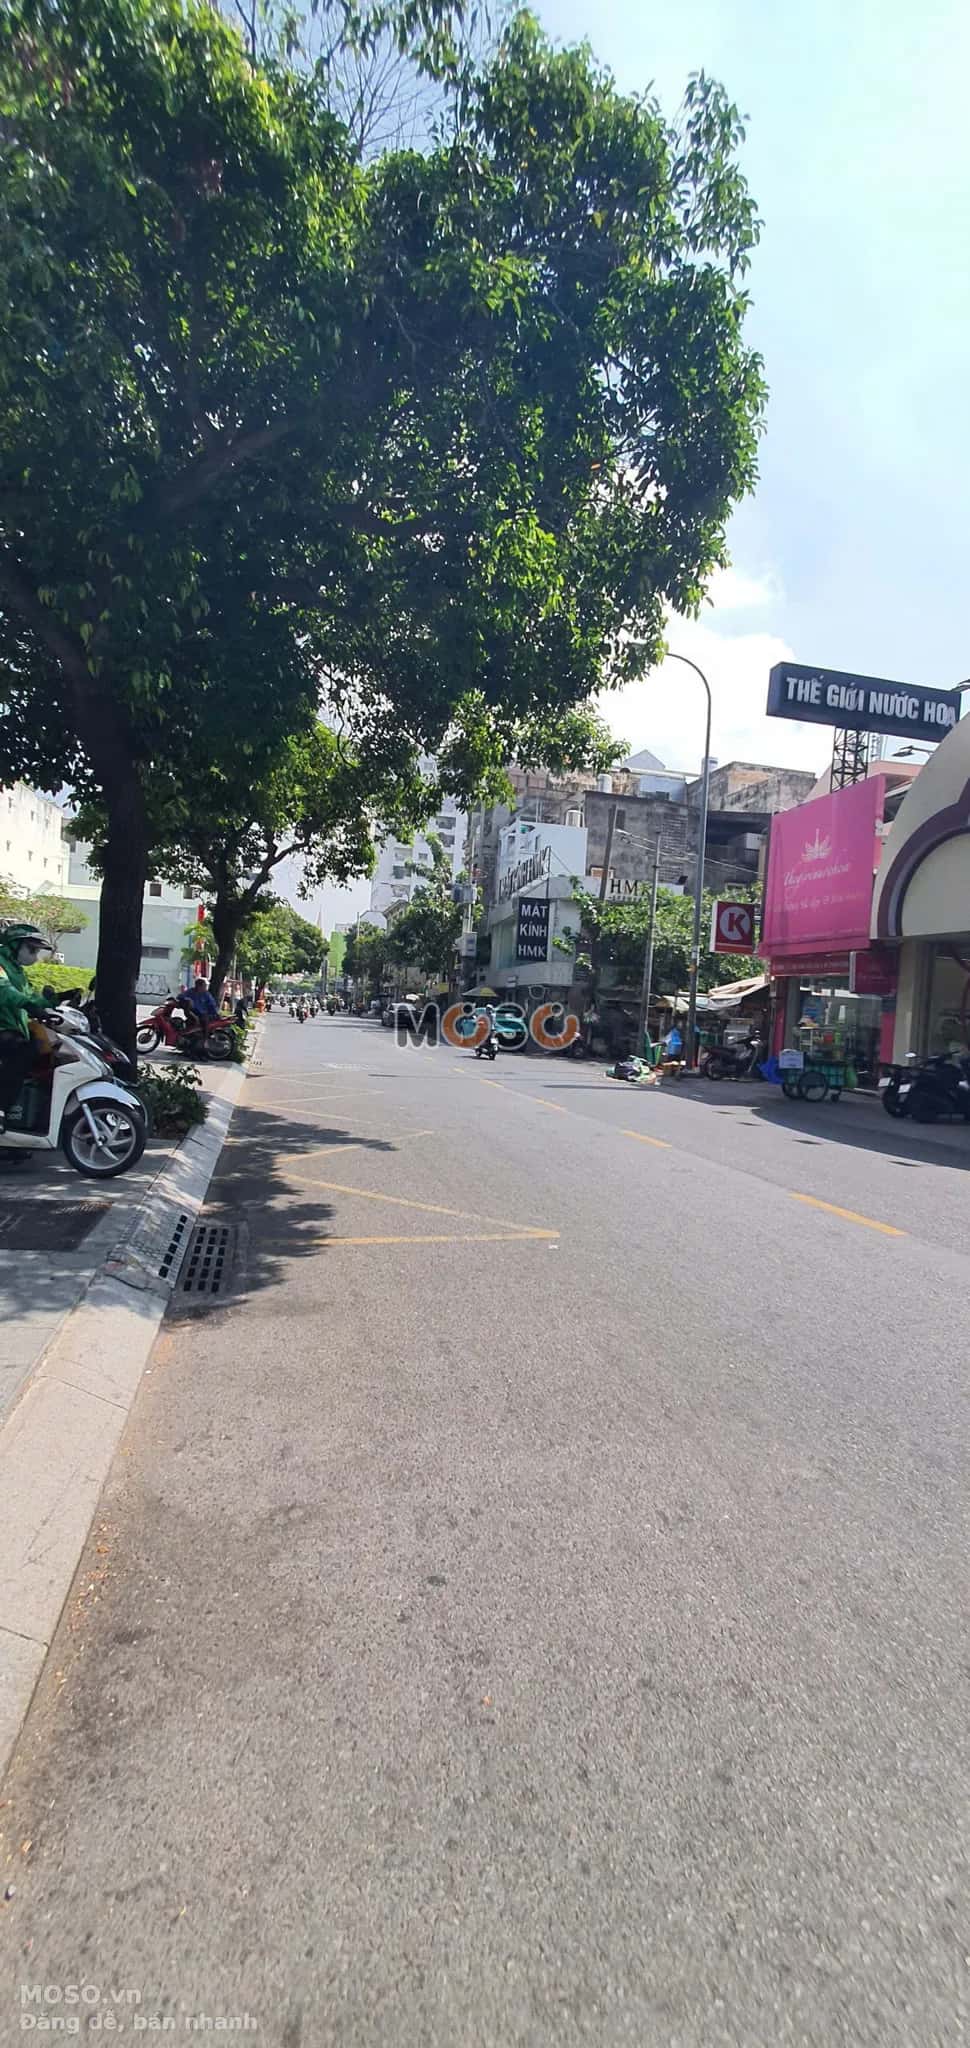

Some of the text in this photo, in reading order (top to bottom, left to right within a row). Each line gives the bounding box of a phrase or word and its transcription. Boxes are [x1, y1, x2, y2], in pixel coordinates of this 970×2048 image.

[786, 675, 957, 727] THẾ GIỚI NƯỚC HOA
[520, 921, 547, 937] KÍNH
[727, 912, 751, 942] K
[518, 944, 546, 958] HMK
